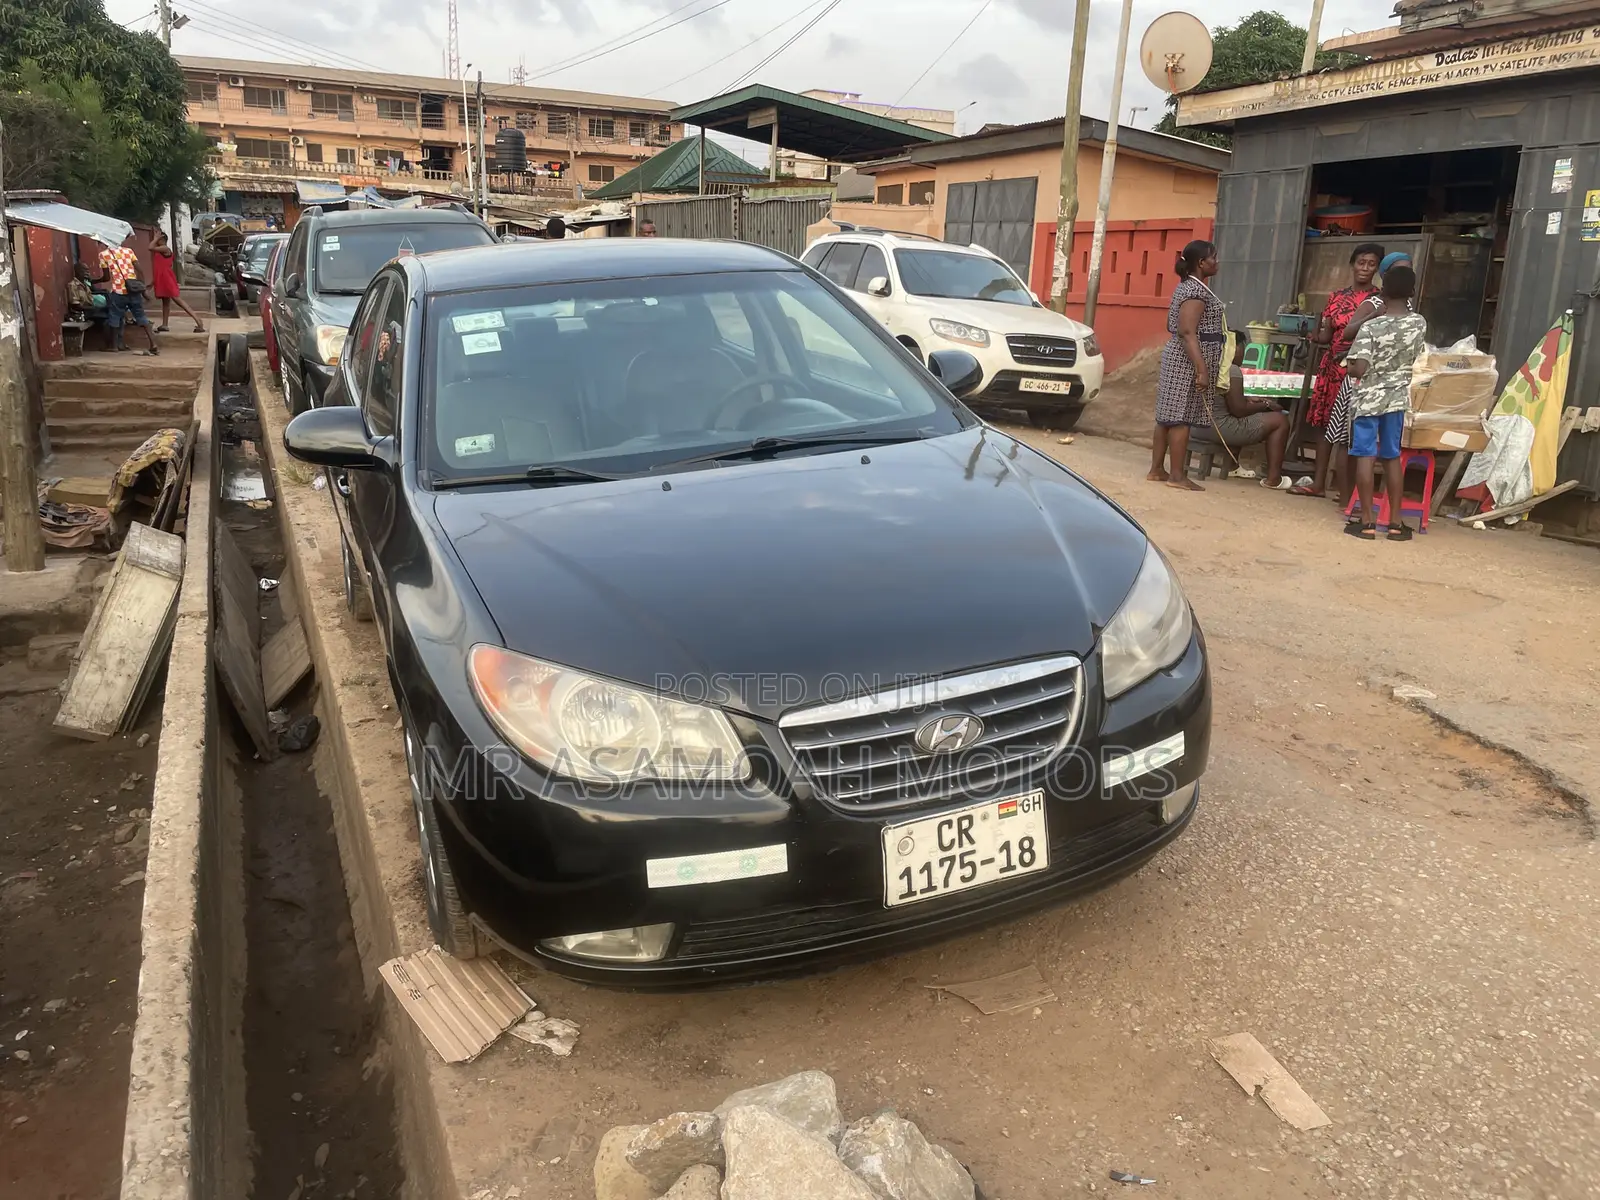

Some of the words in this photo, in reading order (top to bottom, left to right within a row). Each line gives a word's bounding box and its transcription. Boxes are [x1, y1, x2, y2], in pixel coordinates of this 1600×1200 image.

[1434, 47, 1479, 67] Dealers
[1483, 62, 1498, 74] TV
[1499, 55, 1546, 72] SATELITE
[1021, 794, 1042, 814] GH
[937, 814, 976, 852] CR
[898, 836, 1037, 900] 1175-18
